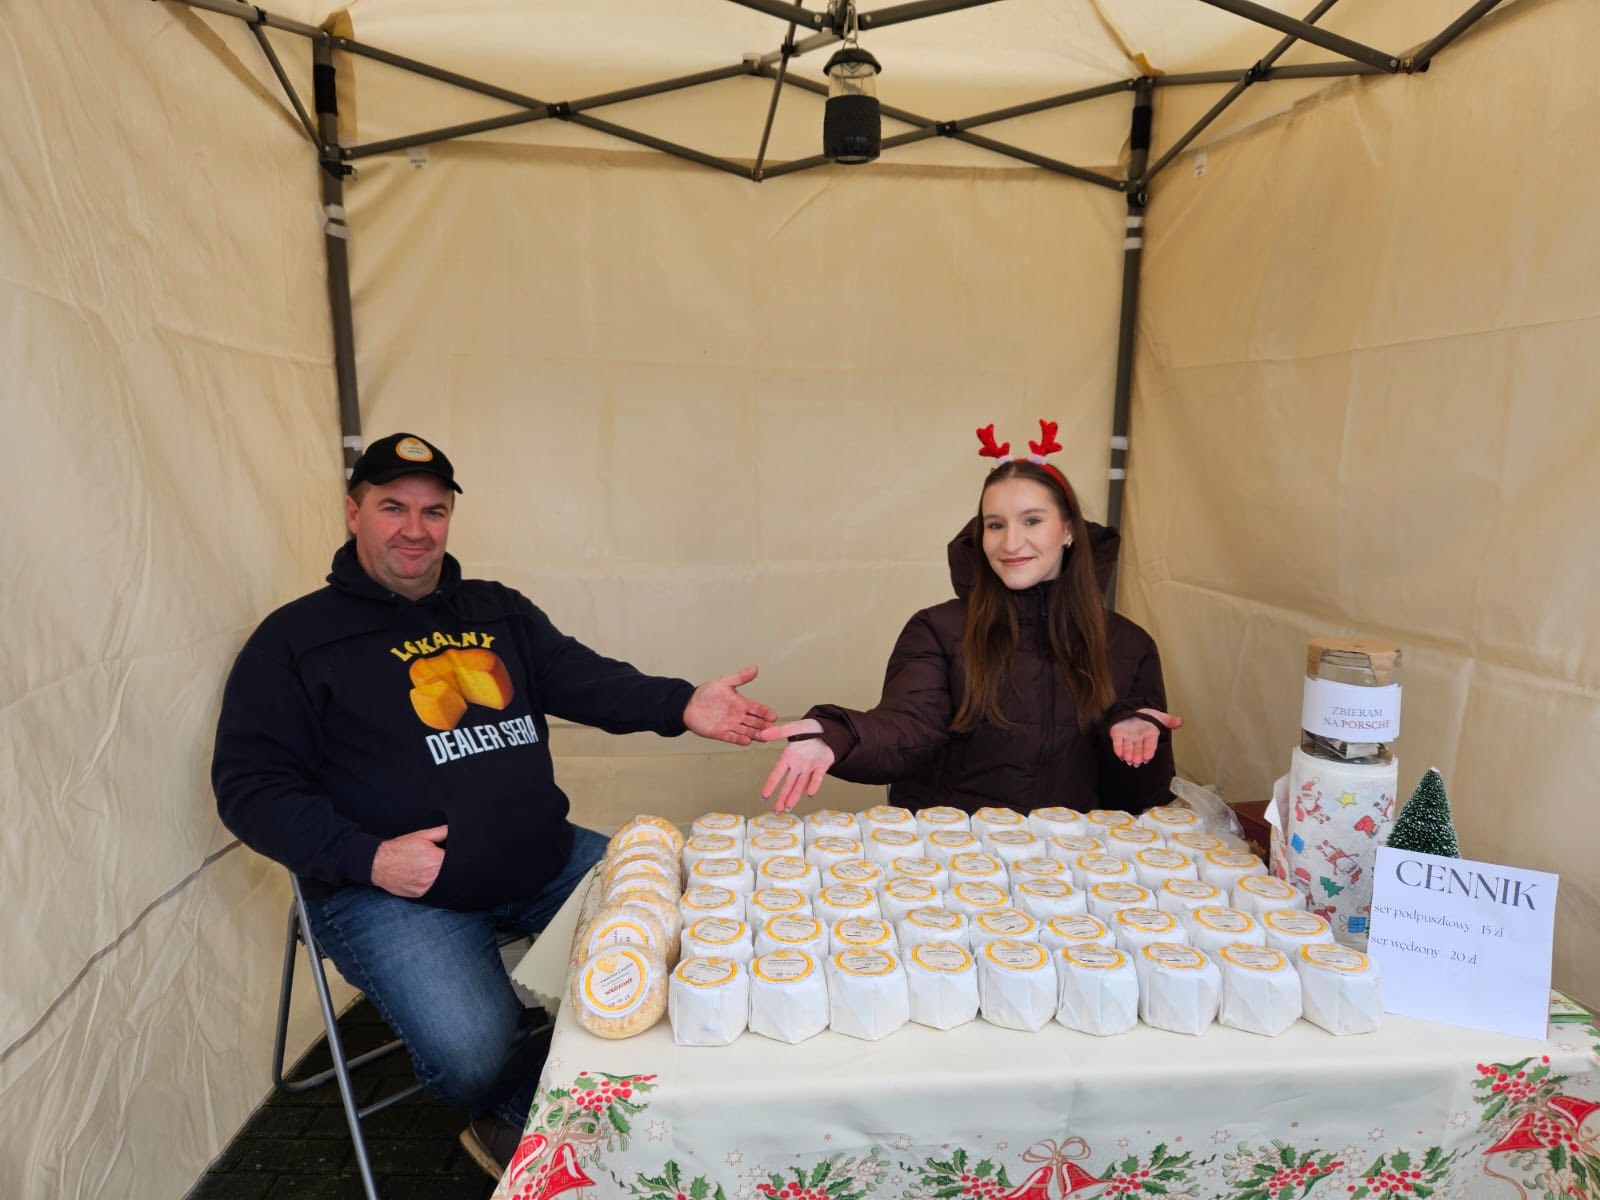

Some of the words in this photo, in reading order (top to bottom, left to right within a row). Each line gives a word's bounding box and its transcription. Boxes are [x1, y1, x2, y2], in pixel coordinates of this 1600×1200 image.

[390, 631, 496, 662] LOKALNY
[1323, 717, 1338, 728] NA
[1340, 719, 1391, 730] PORSCHE
[1331, 705, 1383, 718] ZBIERAM
[425, 723, 506, 766] DEALER
[498, 714, 540, 747] SERA
[1395, 859, 1539, 911] CENNIK
[1373, 904, 1392, 915] ser
[1393, 907, 1472, 933] podpuszkowy
[1481, 924, 1492, 936] 15
[1370, 936, 1388, 946] ser
[1389, 939, 1441, 959] wędzony
[1449, 950, 1466, 962] 20
